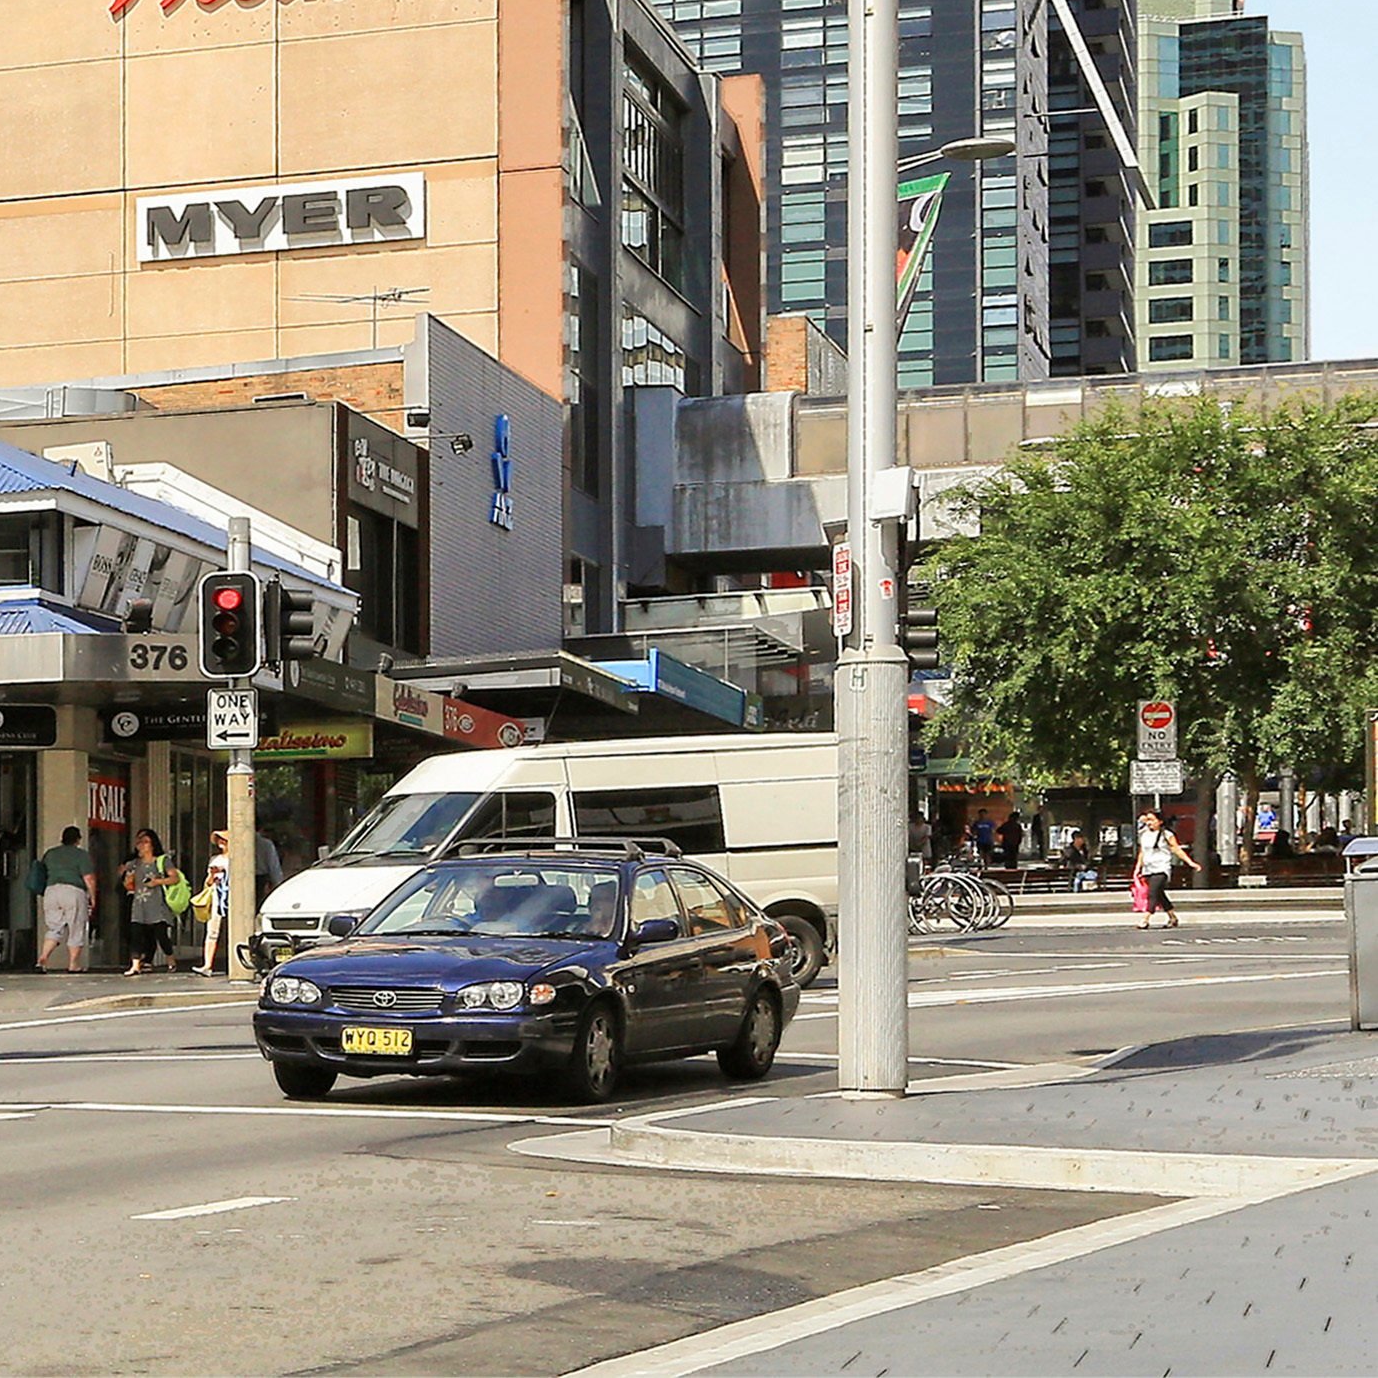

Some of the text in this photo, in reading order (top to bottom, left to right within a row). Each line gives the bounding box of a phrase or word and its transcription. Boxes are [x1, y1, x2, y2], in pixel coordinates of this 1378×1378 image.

[146, 184, 413, 250] MYER
[130, 644, 188, 670] 376
[216, 695, 249, 709] ONE
[215, 713, 250, 726] WAY
[1148, 731, 1166, 740] NO
[100, 784, 125, 824] SALE
[383, 1031, 409, 1047] 512
